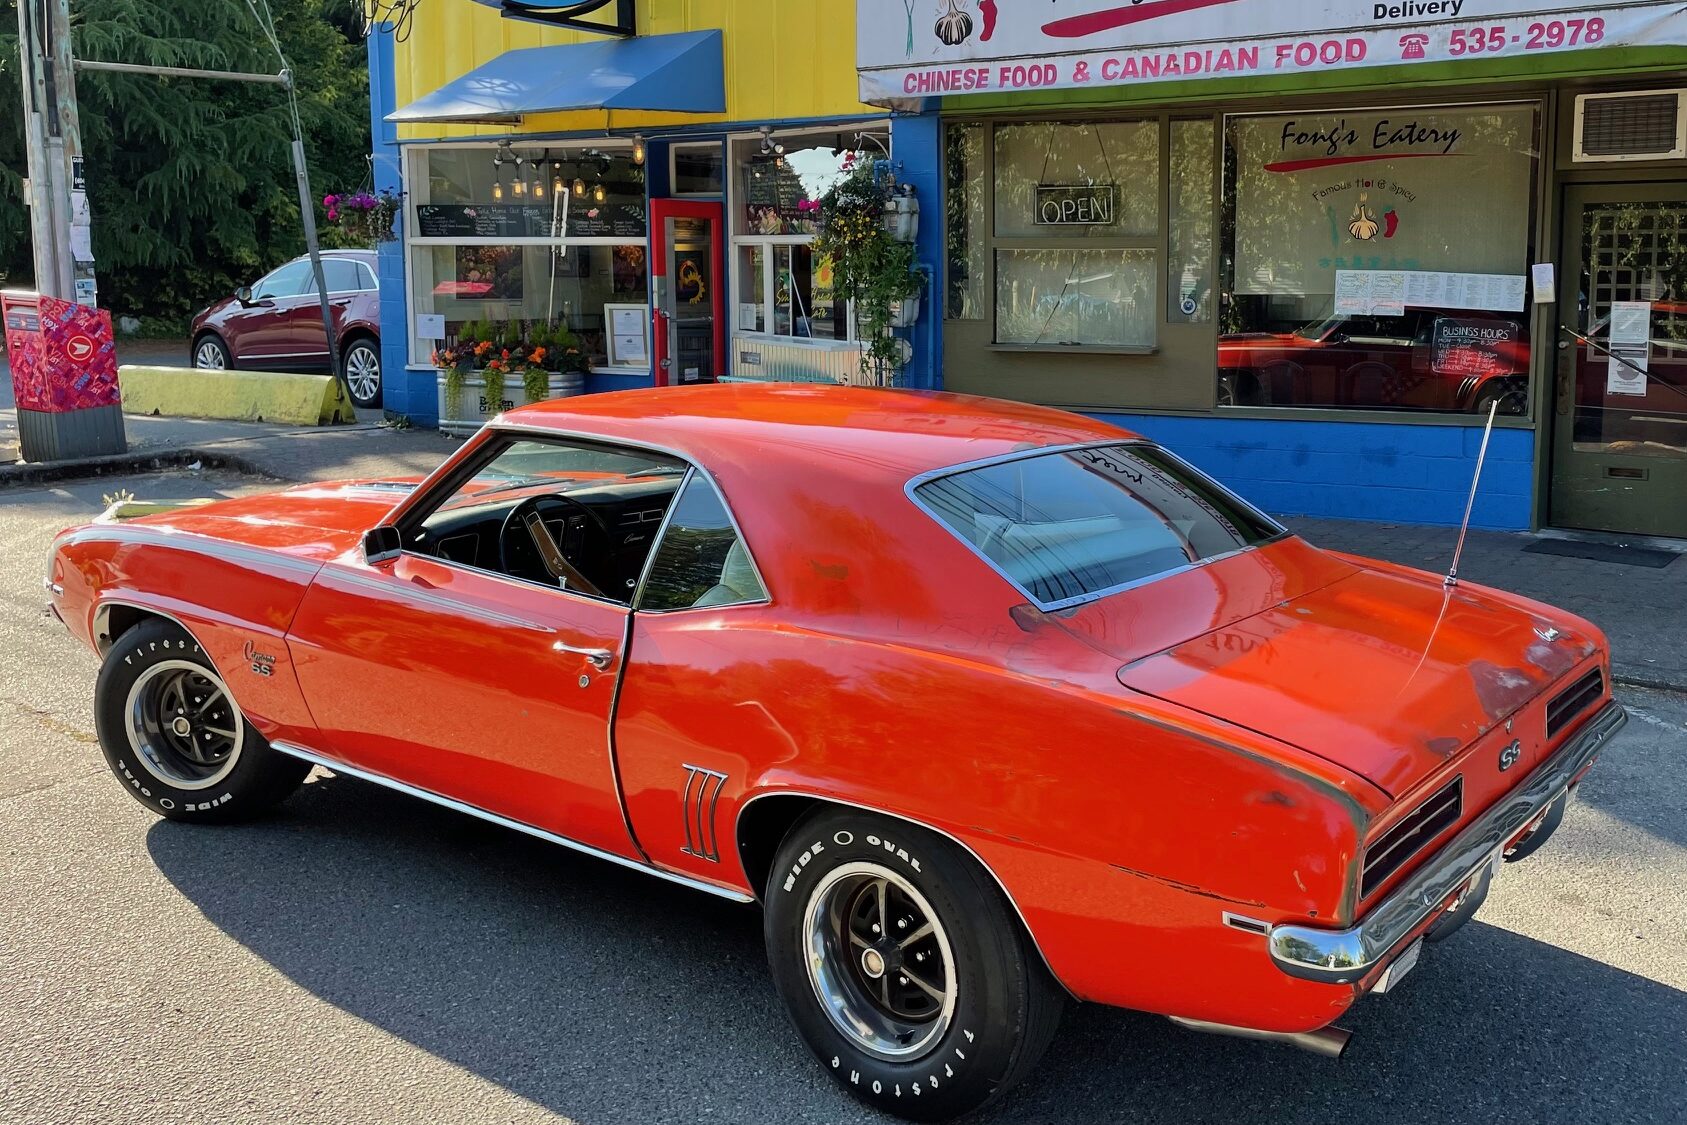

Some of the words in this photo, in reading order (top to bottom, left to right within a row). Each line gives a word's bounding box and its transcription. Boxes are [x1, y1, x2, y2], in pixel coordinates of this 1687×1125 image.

[1373, 0, 1463, 19] Delivery
[903, 69, 990, 94] CHINESE
[999, 64, 1058, 88] FOOD
[1072, 61, 1091, 83] &
[1101, 47, 1260, 81] CANADIAN
[1274, 38, 1368, 69] FOOD
[1281, 119, 1359, 156] Fong's
[1373, 119, 1462, 154] Eatery
[1312, 181, 1352, 201] Famous
[1377, 179, 1387, 190] &
[1389, 182, 1417, 203] Spicy
[1042, 197, 1108, 224] OPEN
[41, 316, 59, 332] H9X
[1442, 325, 1479, 337] BUSINSS
[1480, 328, 1510, 340] HOURS
[251, 662, 272, 677] SS
[1499, 738, 1522, 772] SS
[118, 759, 152, 797] OVAL
[185, 792, 233, 811] WIDE
[783, 841, 825, 892] WIDE
[866, 835, 923, 873] OVAL
[832, 1029, 974, 1097] Firestone
